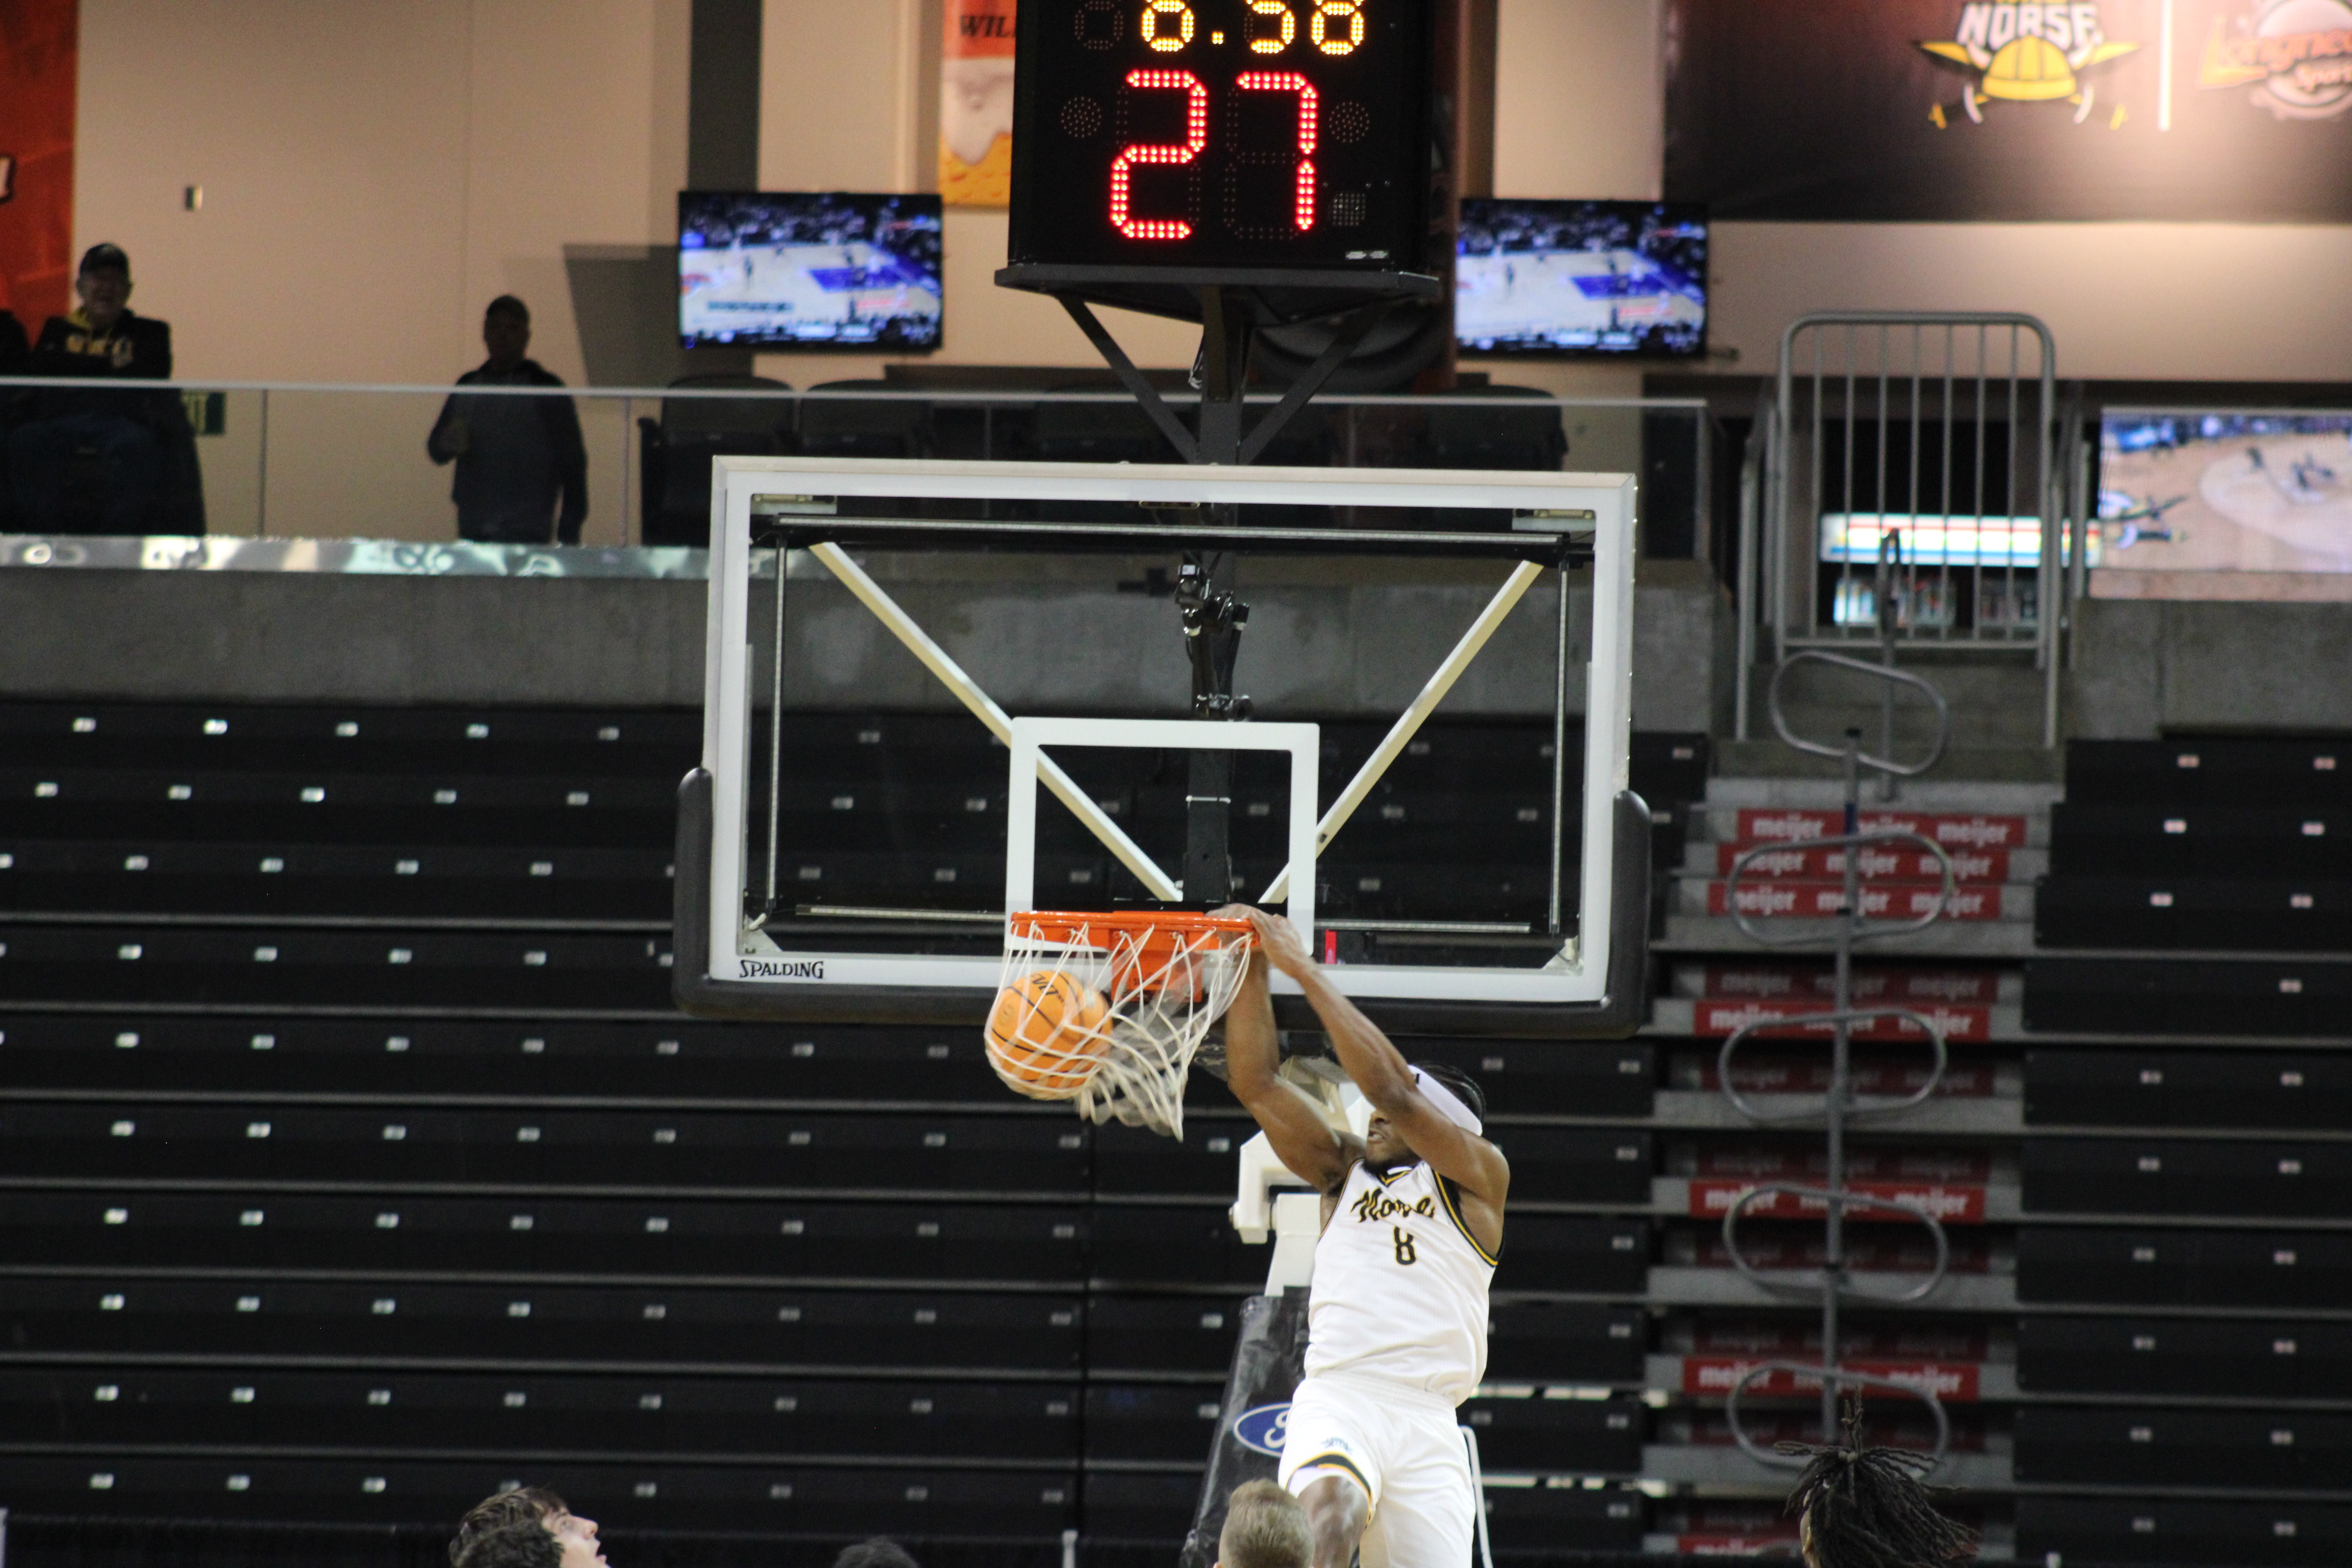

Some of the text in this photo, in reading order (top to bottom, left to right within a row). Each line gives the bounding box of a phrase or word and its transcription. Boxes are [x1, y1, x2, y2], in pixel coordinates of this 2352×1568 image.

[959, 15, 1016, 38] WIL
[1957, 3, 2104, 50] NORSE
[1110, 70, 1318, 238] 27
[1753, 813, 1824, 843] meijer
[1937, 818, 2009, 848] meijer
[1826, 847, 1899, 878] mijer
[1919, 851, 1992, 880] mijer
[1817, 887, 1890, 917] mejer
[1911, 888, 1984, 918] mejer
[740, 959, 824, 979] SPALDING
[1394, 1226, 1416, 1265] 8
